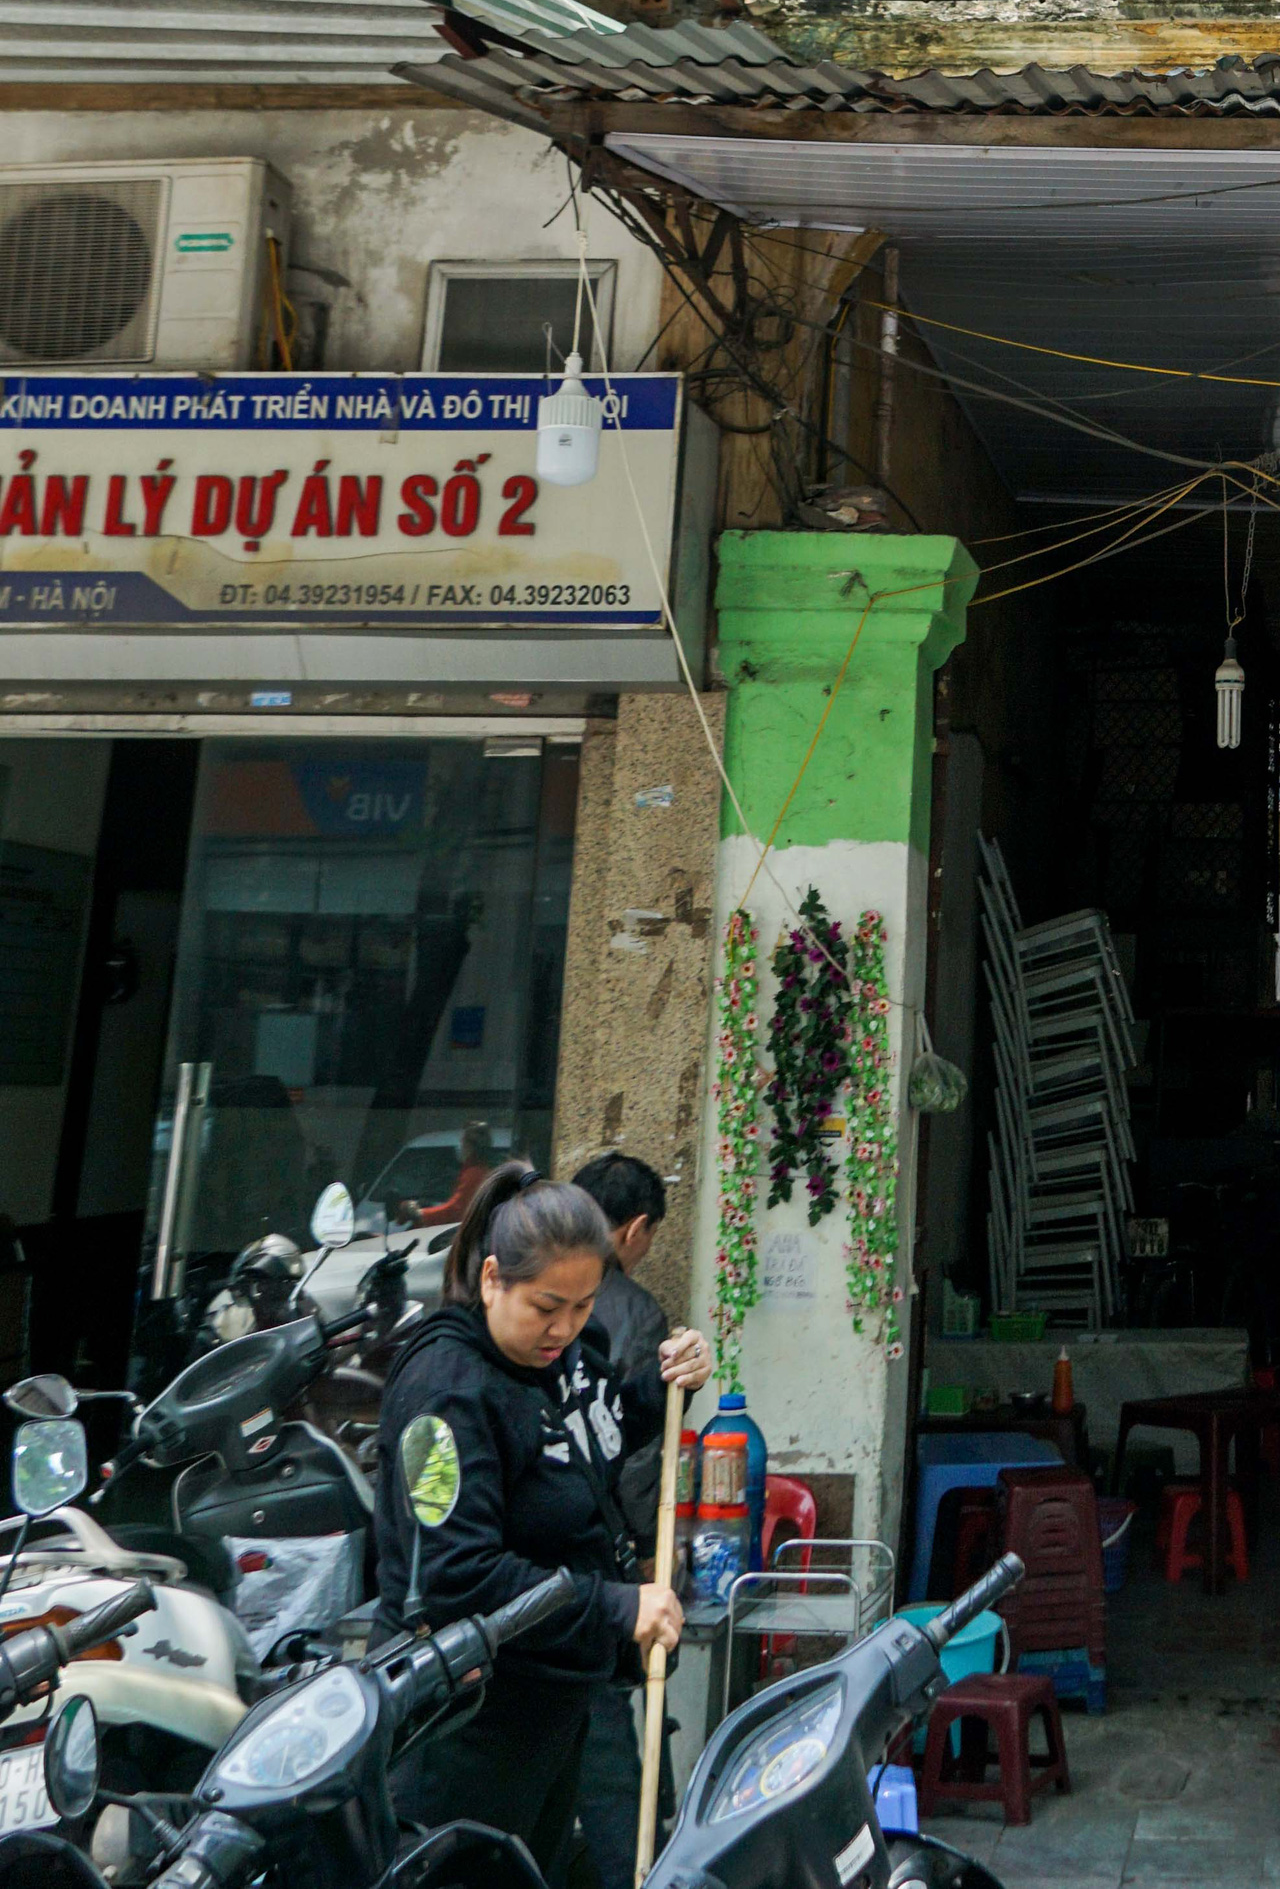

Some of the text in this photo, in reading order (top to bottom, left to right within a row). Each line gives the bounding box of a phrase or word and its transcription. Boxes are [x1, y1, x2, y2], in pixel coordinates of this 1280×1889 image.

[1, 395, 64, 419] KINH
[68, 395, 167, 420] DOANH
[172, 389, 246, 420] PHÁT
[252, 383, 329, 420] TRIỂN
[335, 389, 392, 420] NHÀ
[400, 389, 436, 419] VÀ
[442, 389, 482, 419] ĐÔ
[488, 395, 531, 423] THỊ
[0, 449, 539, 552] ẢN LÝ DỰ ÁN SỐ 2
[30, 580, 64, 609] HÀ
[71, 580, 117, 617] NỘI
[219, 584, 258, 606] ĐT:
[264, 584, 406, 606] 04.39231954
[427, 585, 482, 606] FAX:
[490, 585, 631, 606] 04.39232063
